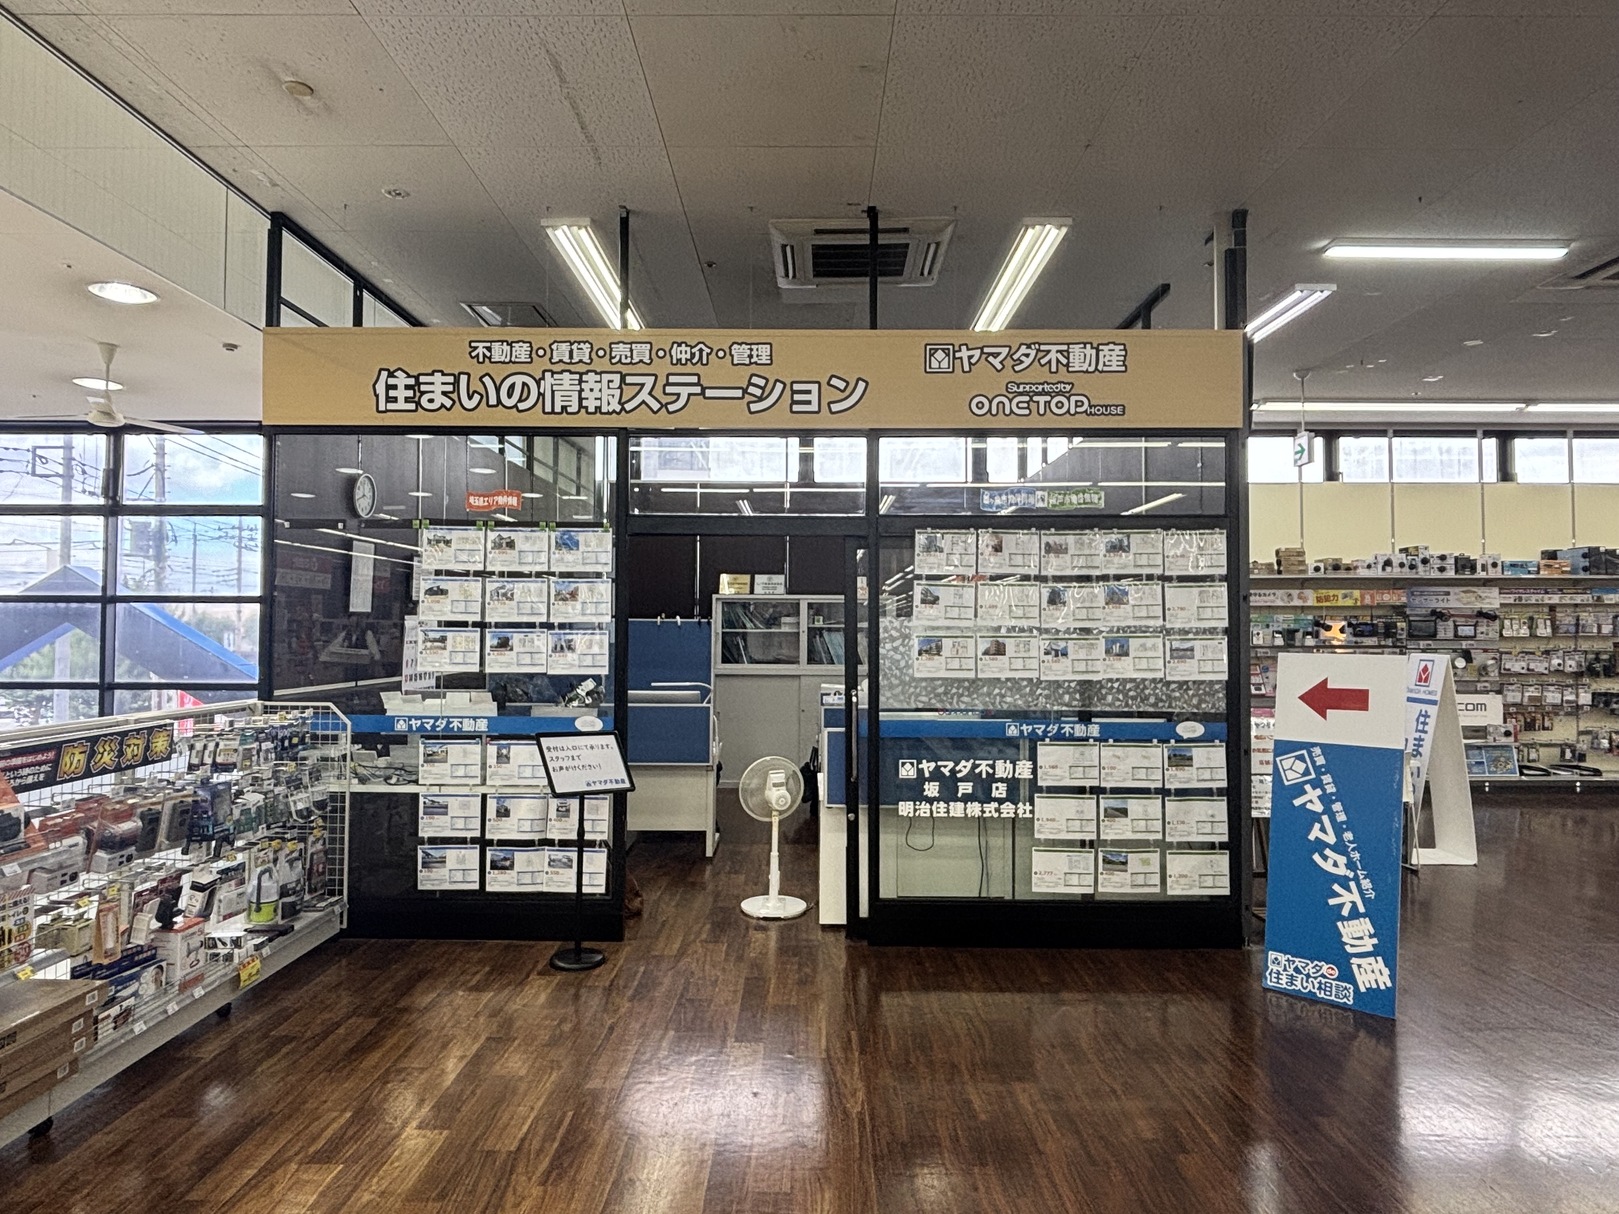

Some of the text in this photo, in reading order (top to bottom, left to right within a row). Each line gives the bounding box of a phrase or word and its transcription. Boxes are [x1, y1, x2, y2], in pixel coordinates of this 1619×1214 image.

[470, 341, 772, 367] 不動産・賃貸・売買・仲介・管理
[954, 343, 1127, 373] ヤマダ不動産
[374, 368, 869, 415] 住まいの情報ステーション
[408, 717, 488, 731] ヤマダ不動産
[1020, 723, 1101, 737] ヤマダ不動産
[57, 727, 174, 781] 防災対策
[591, 778, 626, 786] ヤマダ不動産
[918, 760, 1034, 779] ヤマダ不動産
[898, 802, 1033, 818] 明治住建株式会社
[1292, 784, 1393, 993] ヤマダ不動産
[1266, 967, 1354, 1005] 住まい相談
